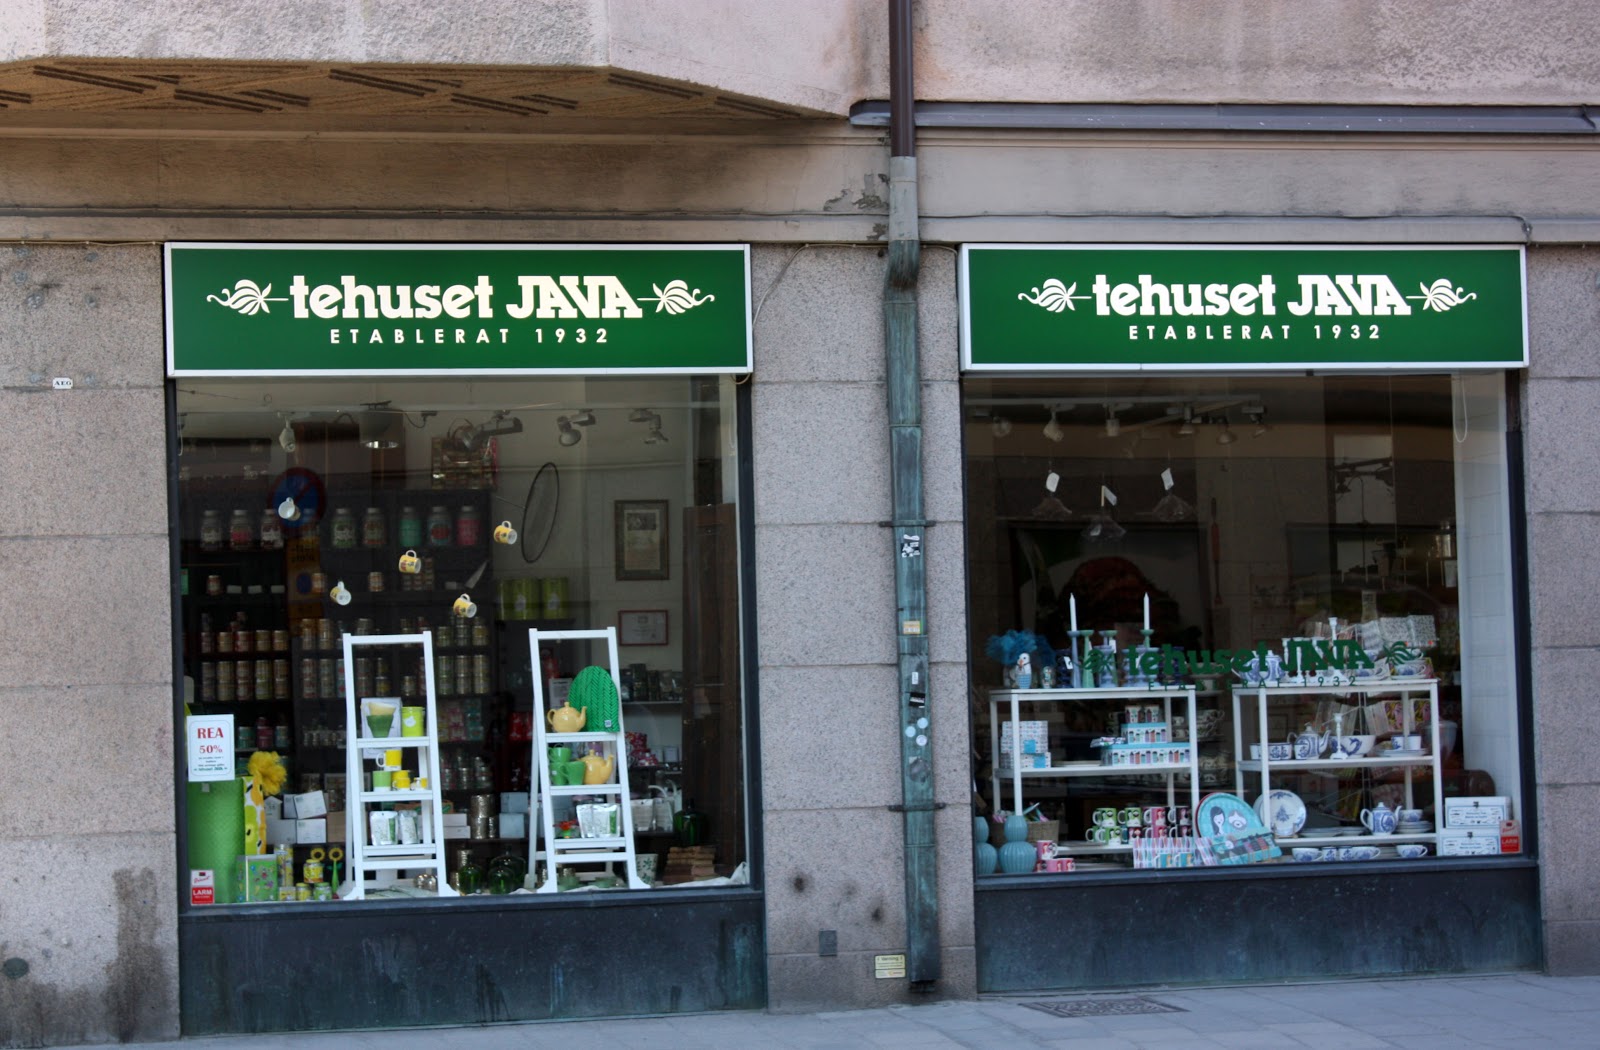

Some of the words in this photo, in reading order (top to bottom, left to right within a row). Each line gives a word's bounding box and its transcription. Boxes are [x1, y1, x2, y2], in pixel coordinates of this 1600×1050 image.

[289, 275, 493, 319] tehuset
[506, 275, 643, 319] JAVA
[1092, 274, 1276, 317] tehuset
[1287, 274, 1412, 316] JAVA
[330, 328, 509, 344] ETABLERAT
[535, 328, 607, 344] 1932
[1129, 324, 1290, 340] ETABLERAT
[1313, 324, 1379, 340] 1932
[1127, 641, 1266, 676] tehuset
[1279, 639, 1375, 672] JAVA
[1303, 675, 1357, 688] 1932
[197, 727, 224, 739] REA
[199, 744, 223, 754] 50%
[192, 888, 213, 896] LARM
